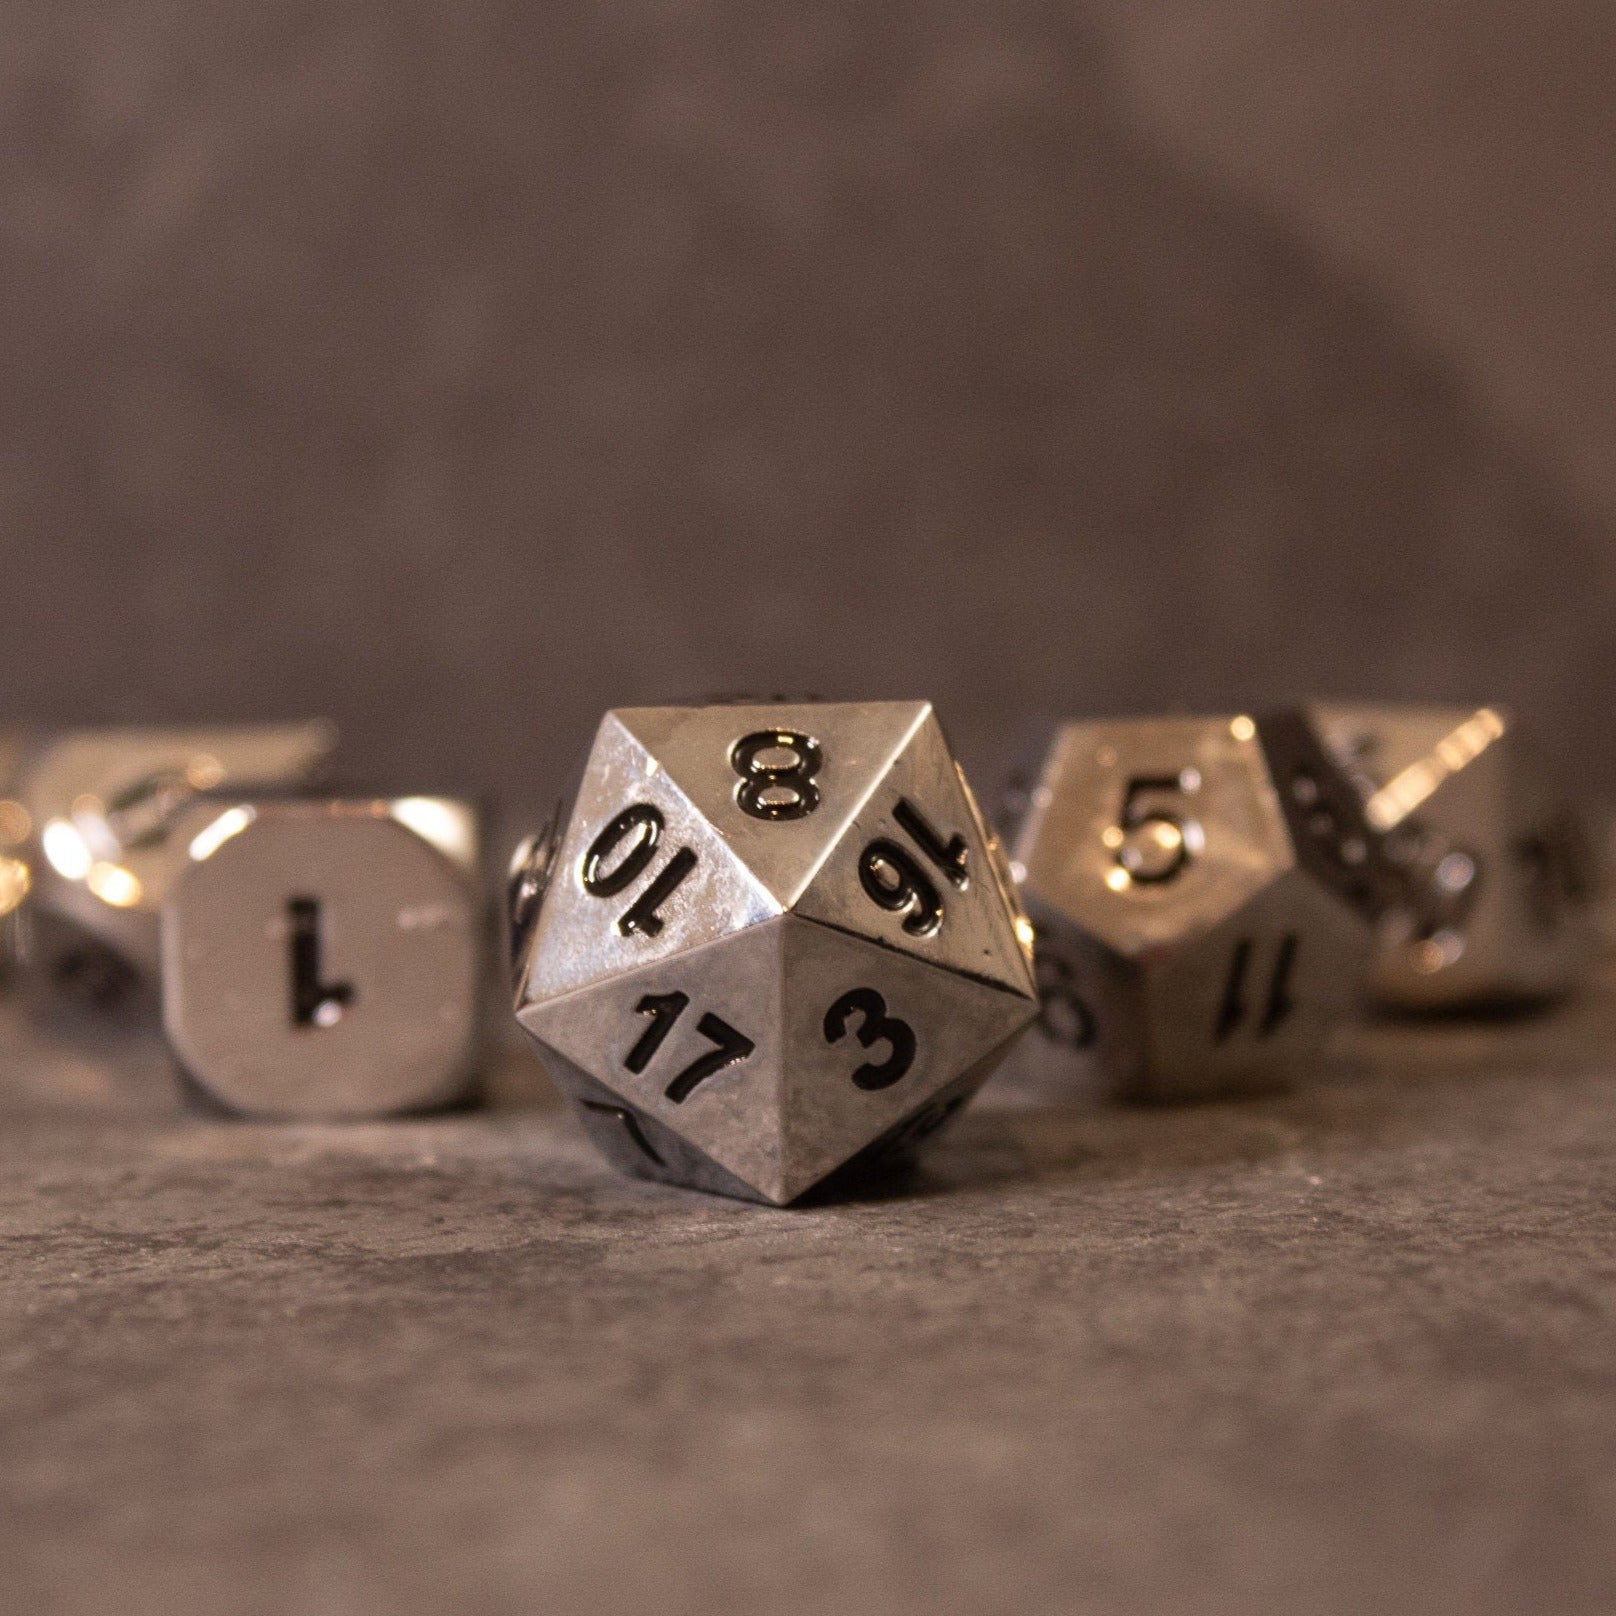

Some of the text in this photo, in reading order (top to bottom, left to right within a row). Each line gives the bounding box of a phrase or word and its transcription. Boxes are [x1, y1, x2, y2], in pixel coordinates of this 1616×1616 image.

[727, 729, 823, 821] 8
[1108, 775, 1201, 886] 5
[580, 802, 698, 938] 10
[858, 797, 969, 938] 16
[287, 895, 356, 1033] 1
[625, 990, 755, 1104] 17
[823, 987, 917, 1092] 3
